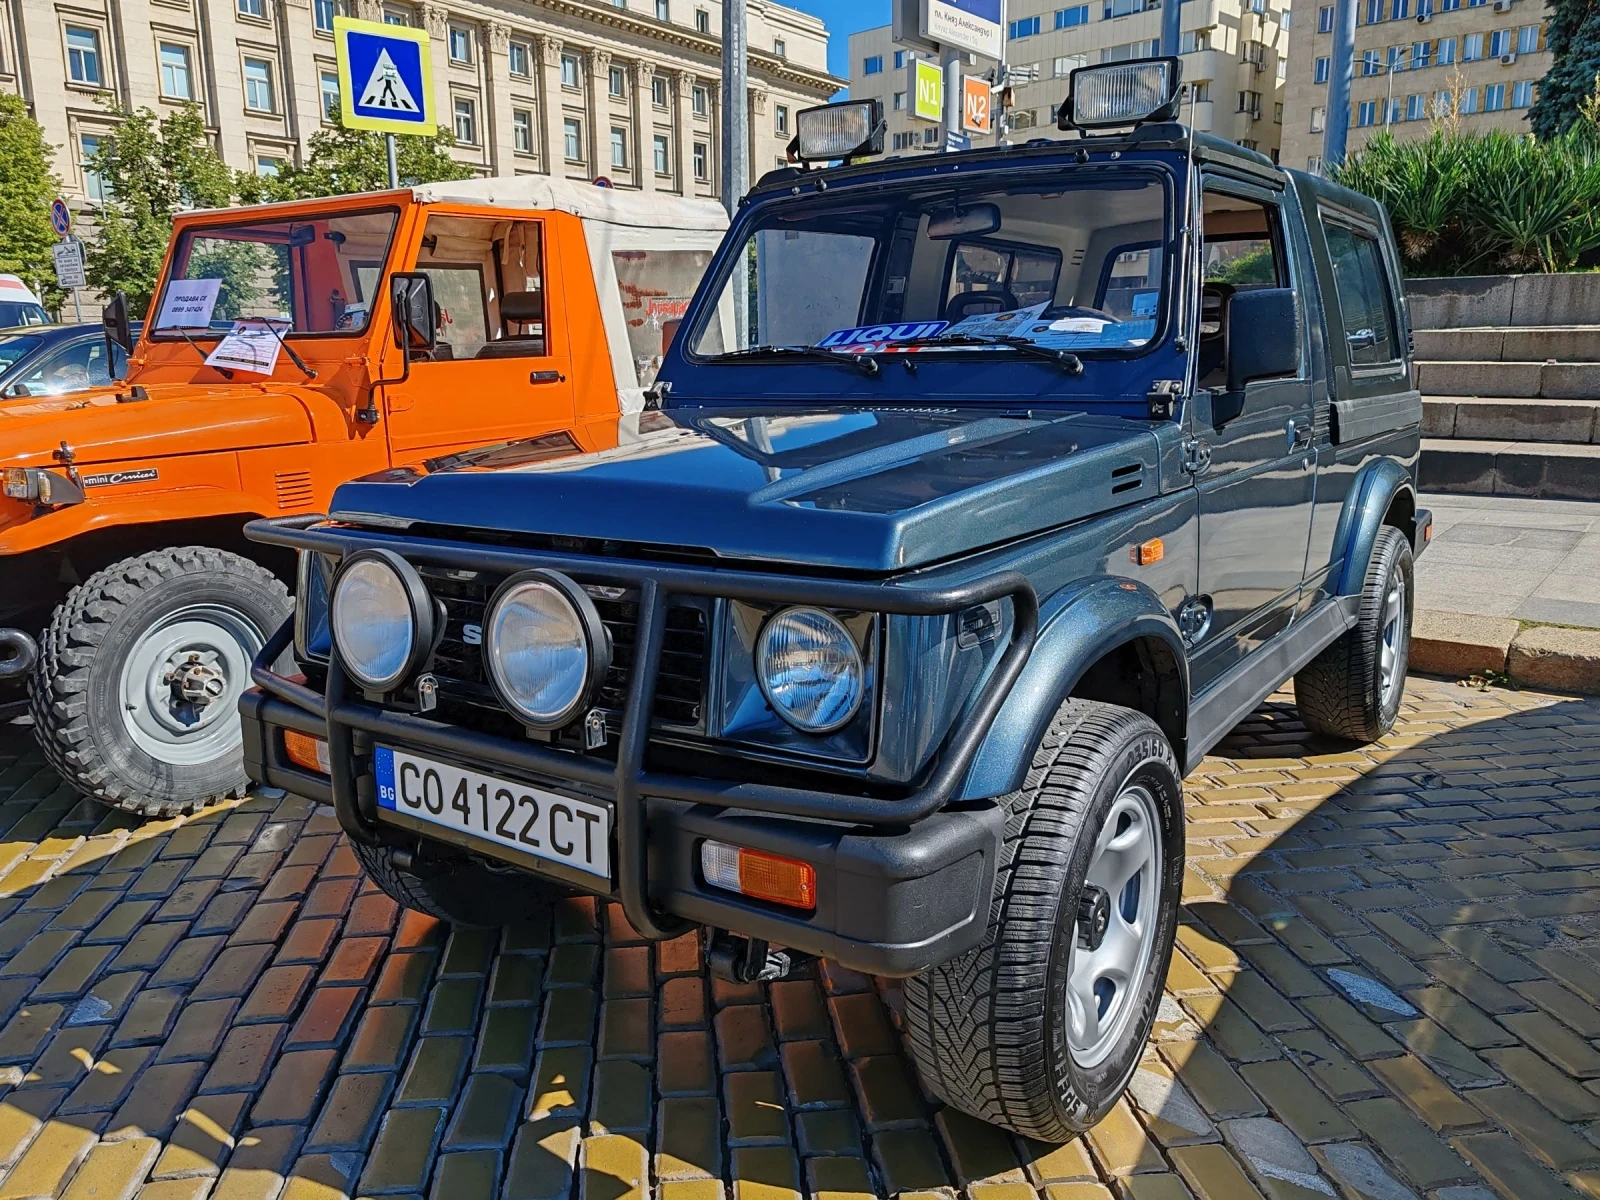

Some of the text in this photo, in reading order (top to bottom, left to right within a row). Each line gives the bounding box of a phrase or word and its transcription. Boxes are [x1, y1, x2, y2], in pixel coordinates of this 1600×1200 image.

[944, 12, 958, 27] Княз
[919, 78, 938, 105] N1
[967, 92, 987, 118] N2
[826, 323, 940, 346] LIQUI
[88, 475, 108, 484] mini
[380, 785, 394, 801] BG
[400, 761, 600, 864] CO 4122 CT
